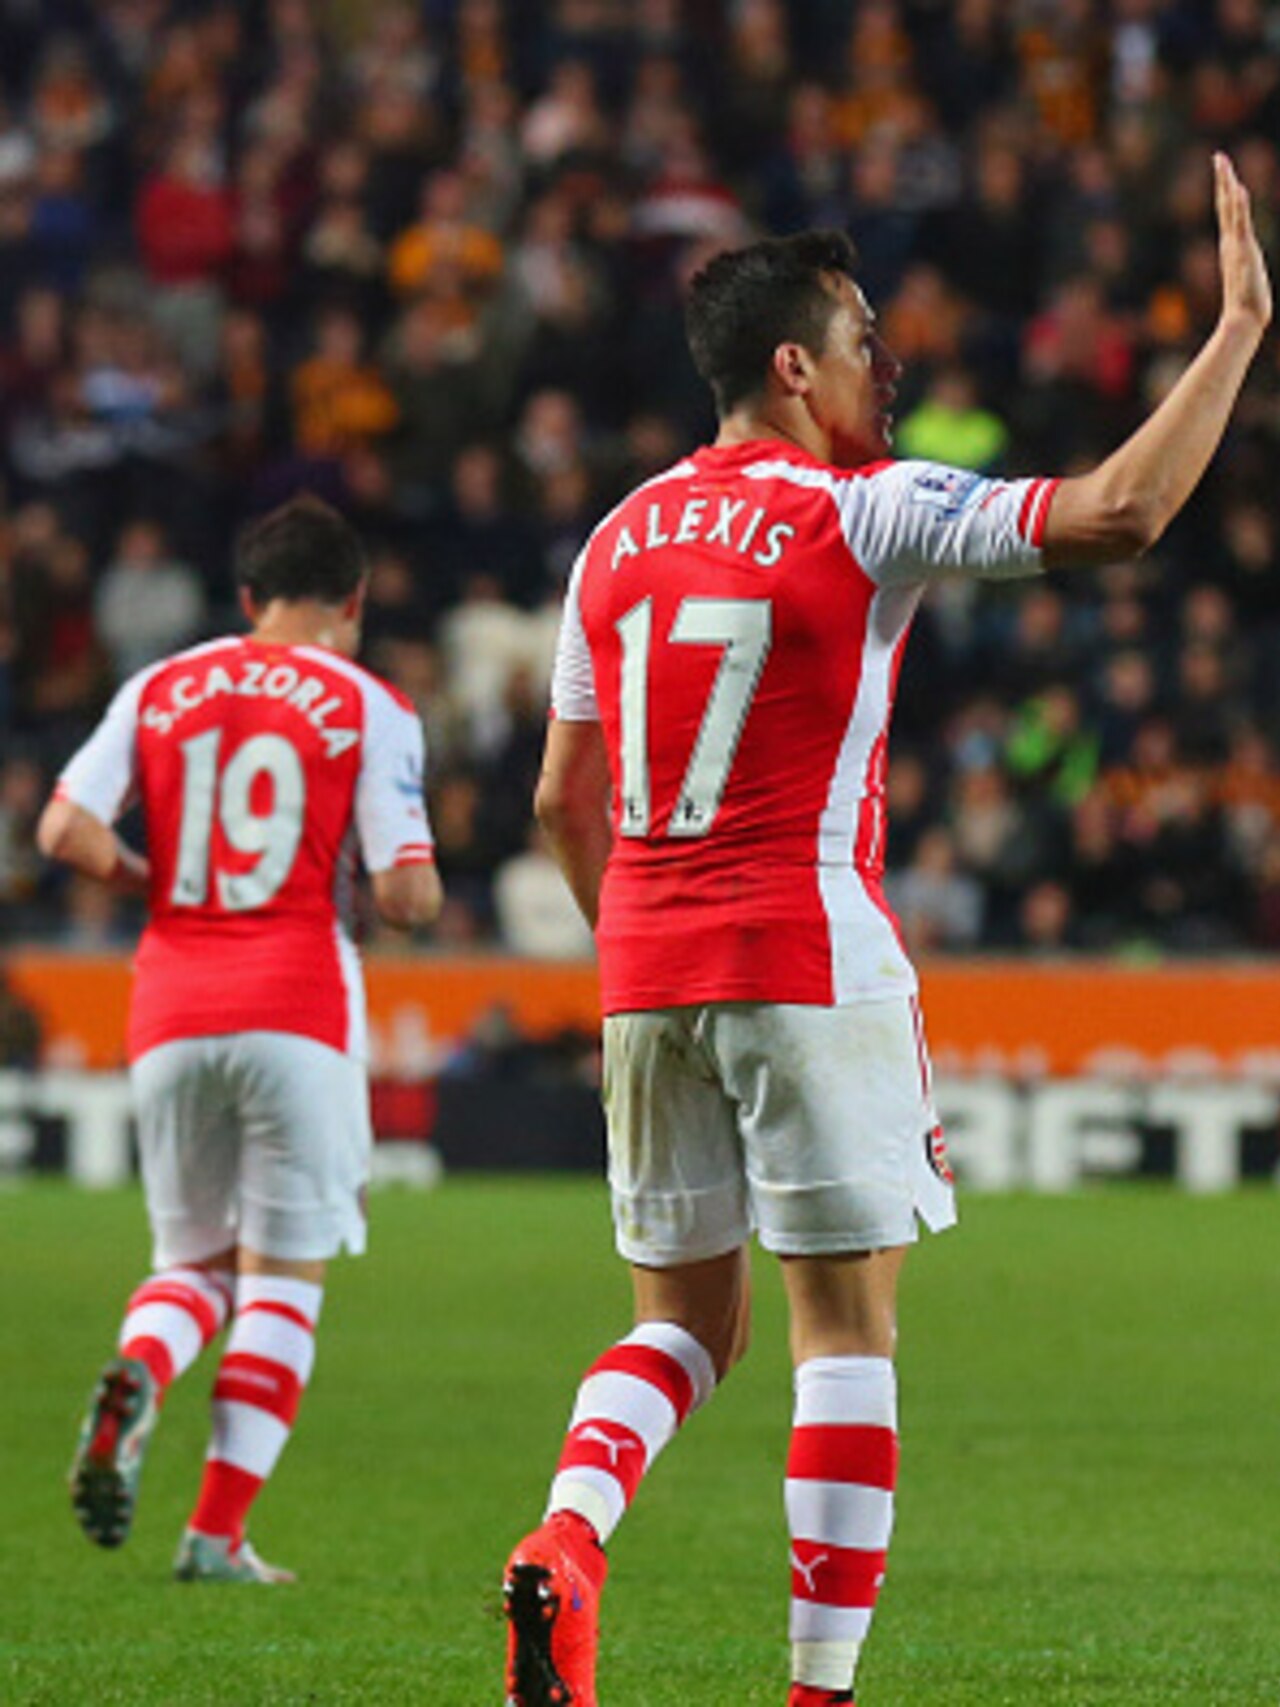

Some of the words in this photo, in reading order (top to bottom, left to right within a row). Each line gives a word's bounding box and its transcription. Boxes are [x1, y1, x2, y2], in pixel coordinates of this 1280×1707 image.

[610, 498, 795, 568] ALEXIS
[141, 661, 361, 759] S.CAZORLA
[614, 594, 773, 837] 17
[170, 726, 306, 912] 19
